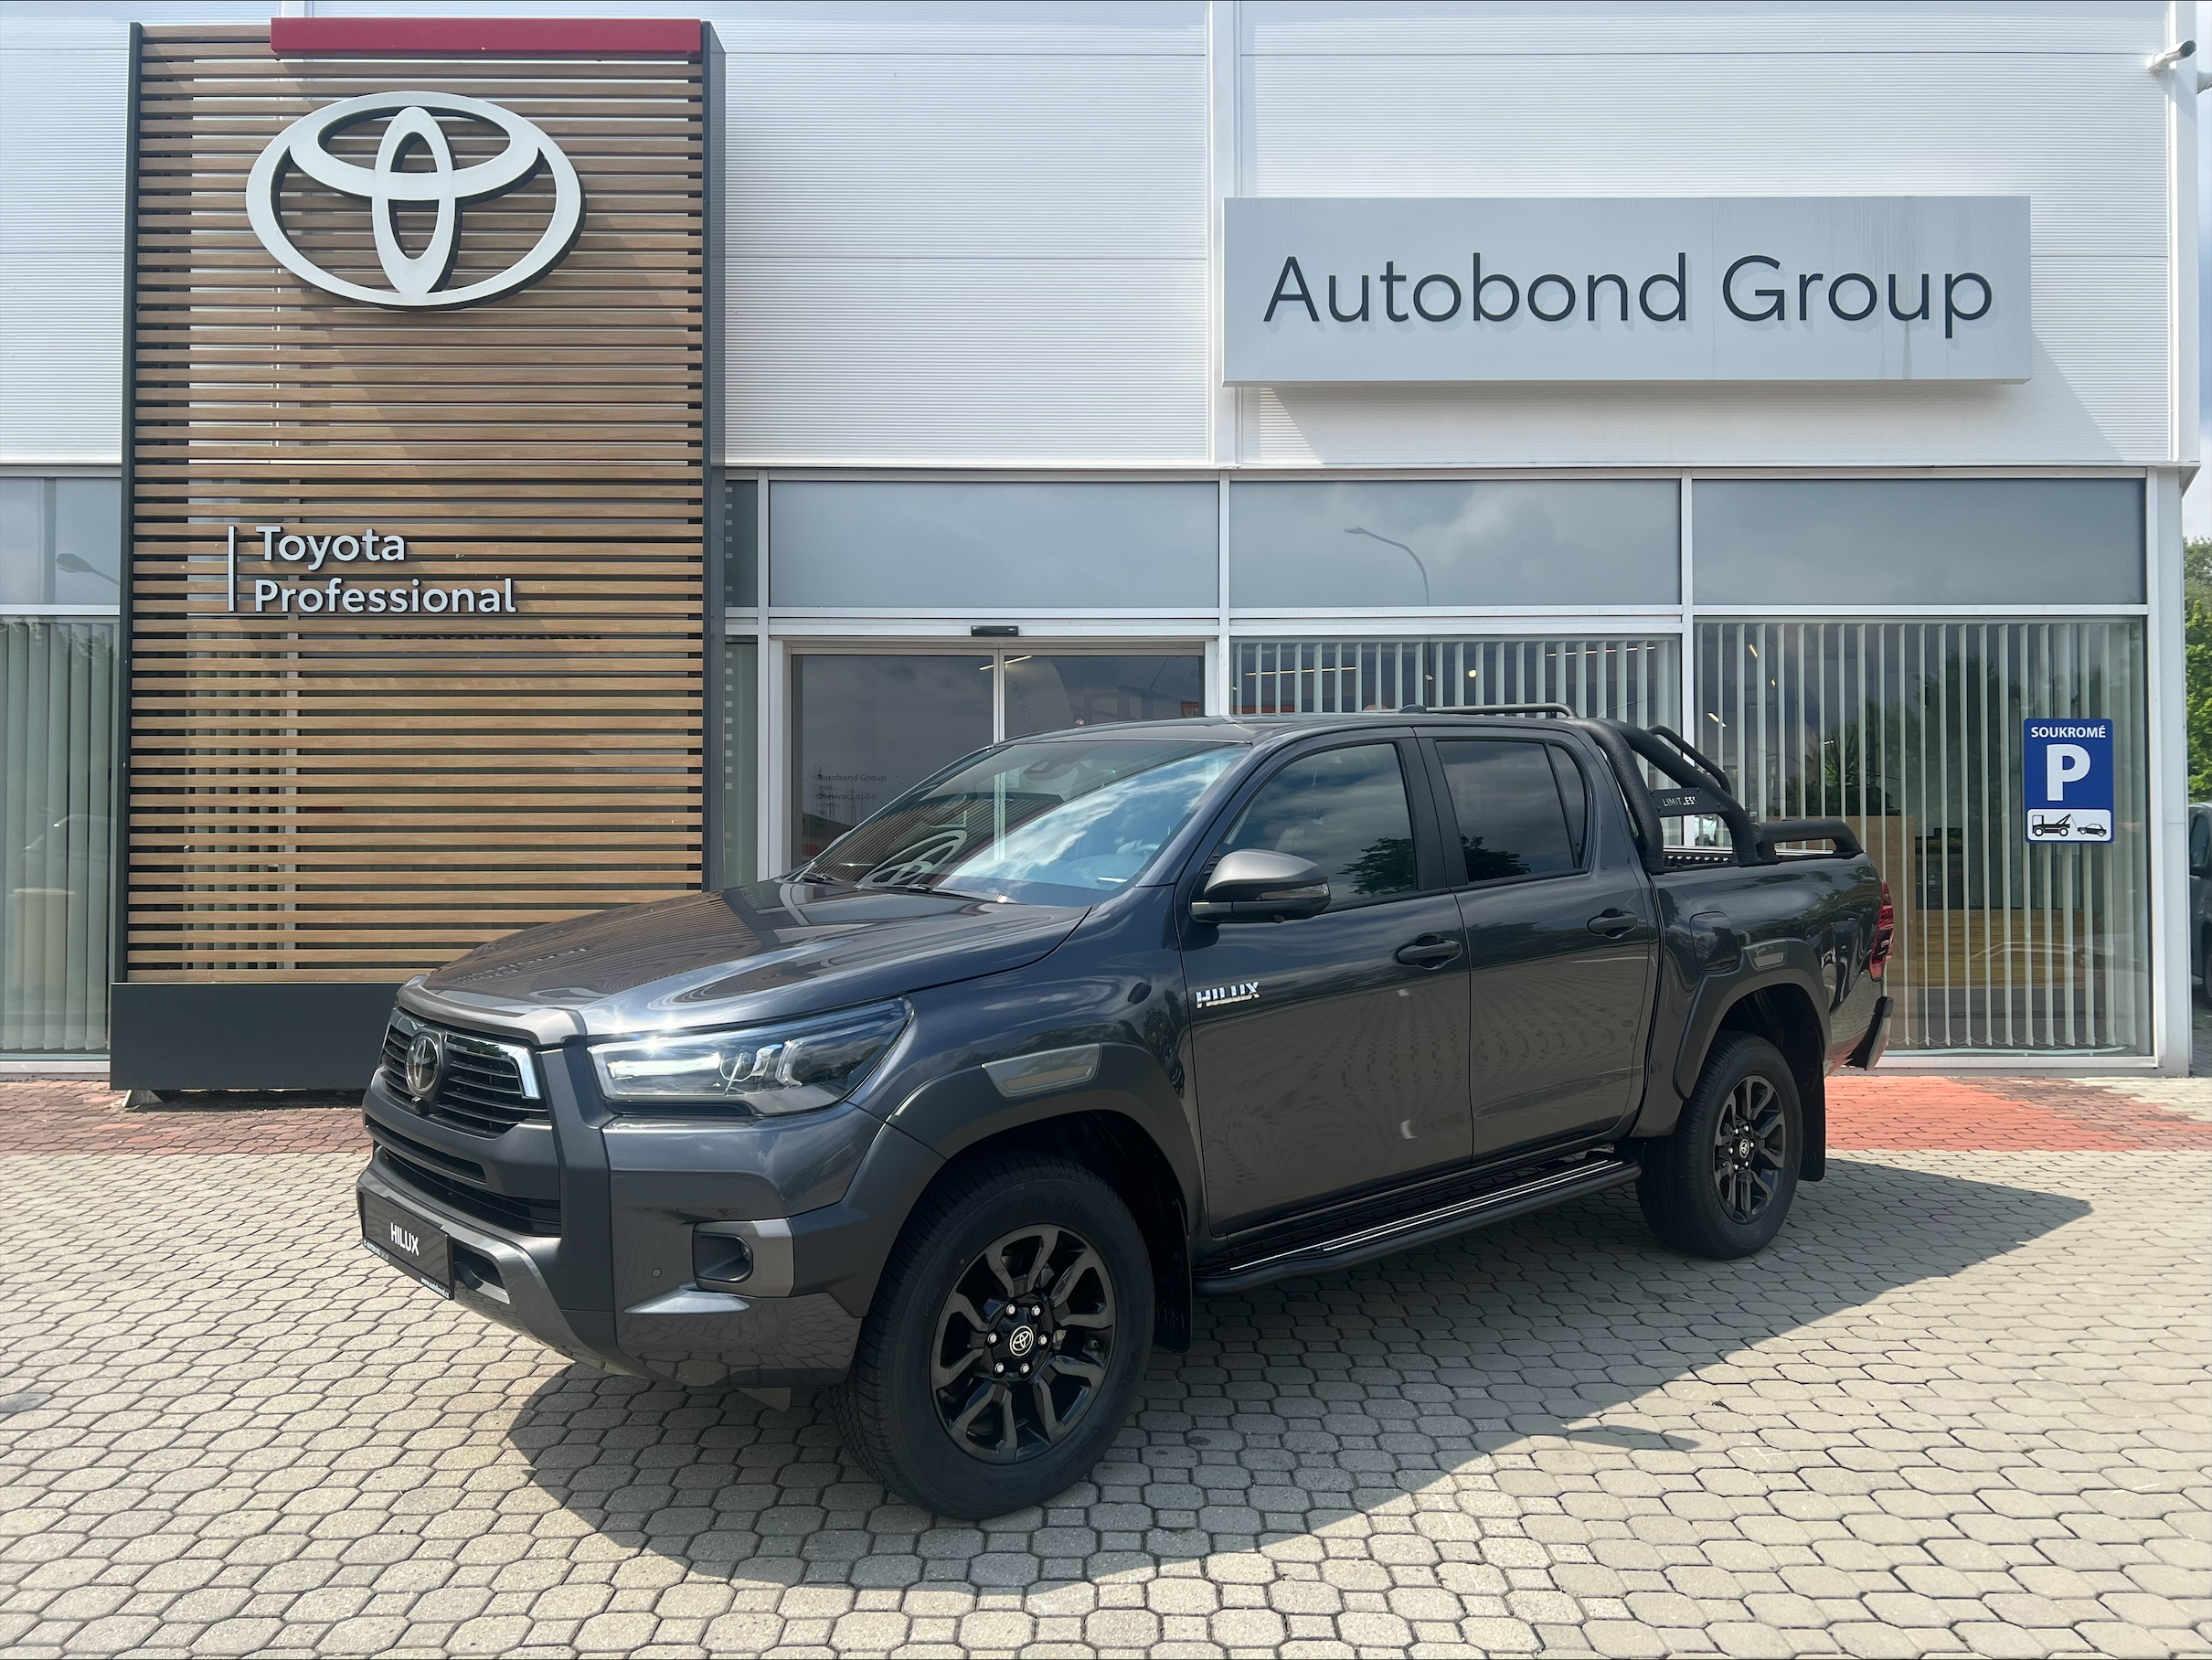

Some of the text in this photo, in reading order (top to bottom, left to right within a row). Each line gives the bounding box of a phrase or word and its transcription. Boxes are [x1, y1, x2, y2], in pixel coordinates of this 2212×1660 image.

[1264, 252, 1994, 339] Autobond Group
[256, 526, 406, 571] Toyota
[255, 577, 516, 613] Professional
[2031, 724, 2107, 739] SOUKROMÉ
[860, 774, 887, 783] Group
[2046, 743, 2091, 802] P
[1196, 981, 1260, 1009] HILUX
[390, 1221, 420, 1257] HILUX
